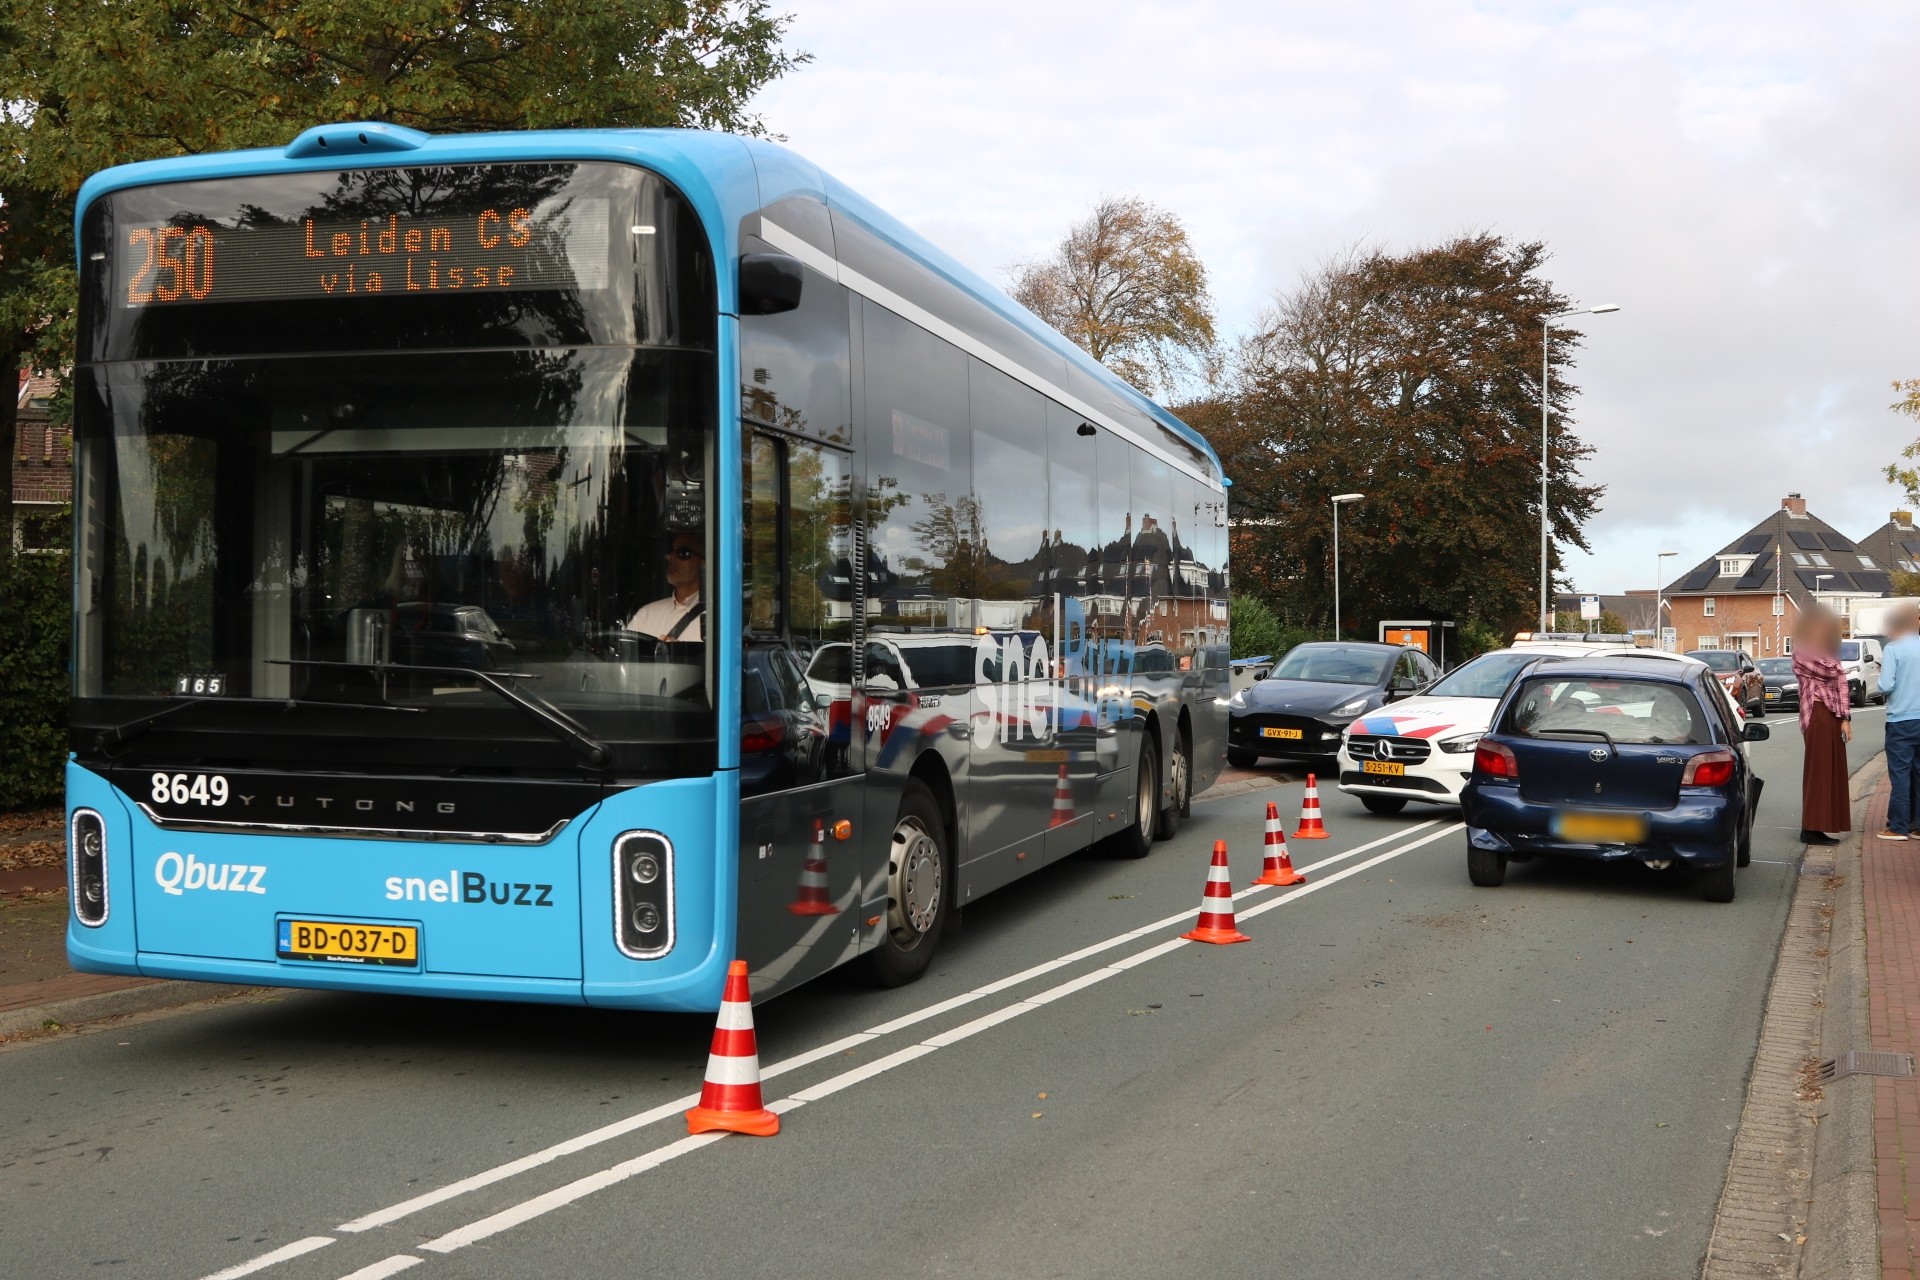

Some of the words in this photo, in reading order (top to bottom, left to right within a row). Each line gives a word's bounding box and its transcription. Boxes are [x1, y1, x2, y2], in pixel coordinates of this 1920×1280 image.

[305, 213, 451, 258] Leiden
[477, 207, 531, 249] CS
[128, 225, 214, 303] 250
[320, 263, 383, 294] via
[406, 257, 514, 292] Lisse
[179, 677, 220, 694] 165
[867, 704, 891, 732] 8649
[1266, 728, 1299, 738] GVX-91-J
[1365, 761, 1400, 774] S-251-KV
[151, 772, 229, 807] 8649
[238, 794, 456, 814] YUTONG
[154, 851, 267, 896] Qbuzz
[384, 869, 554, 908] snelBuzz
[280, 938, 291, 947] NL
[298, 926, 407, 955] BD-037-D
